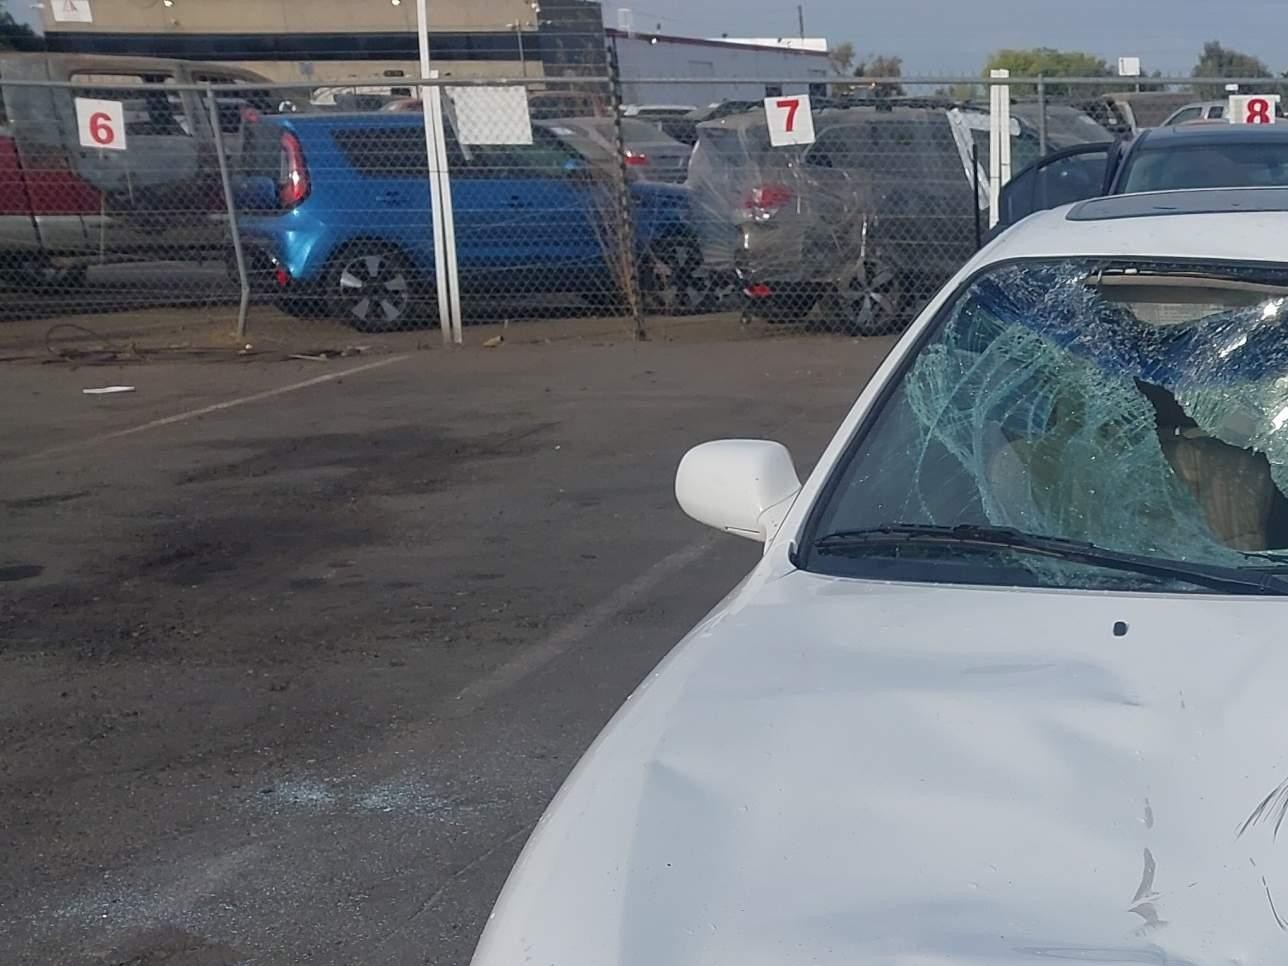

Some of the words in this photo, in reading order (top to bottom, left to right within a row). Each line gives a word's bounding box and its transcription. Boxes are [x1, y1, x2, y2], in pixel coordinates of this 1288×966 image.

[776, 100, 799, 132] 7
[1247, 98, 1270, 124] 8
[90, 112, 114, 144] 6
